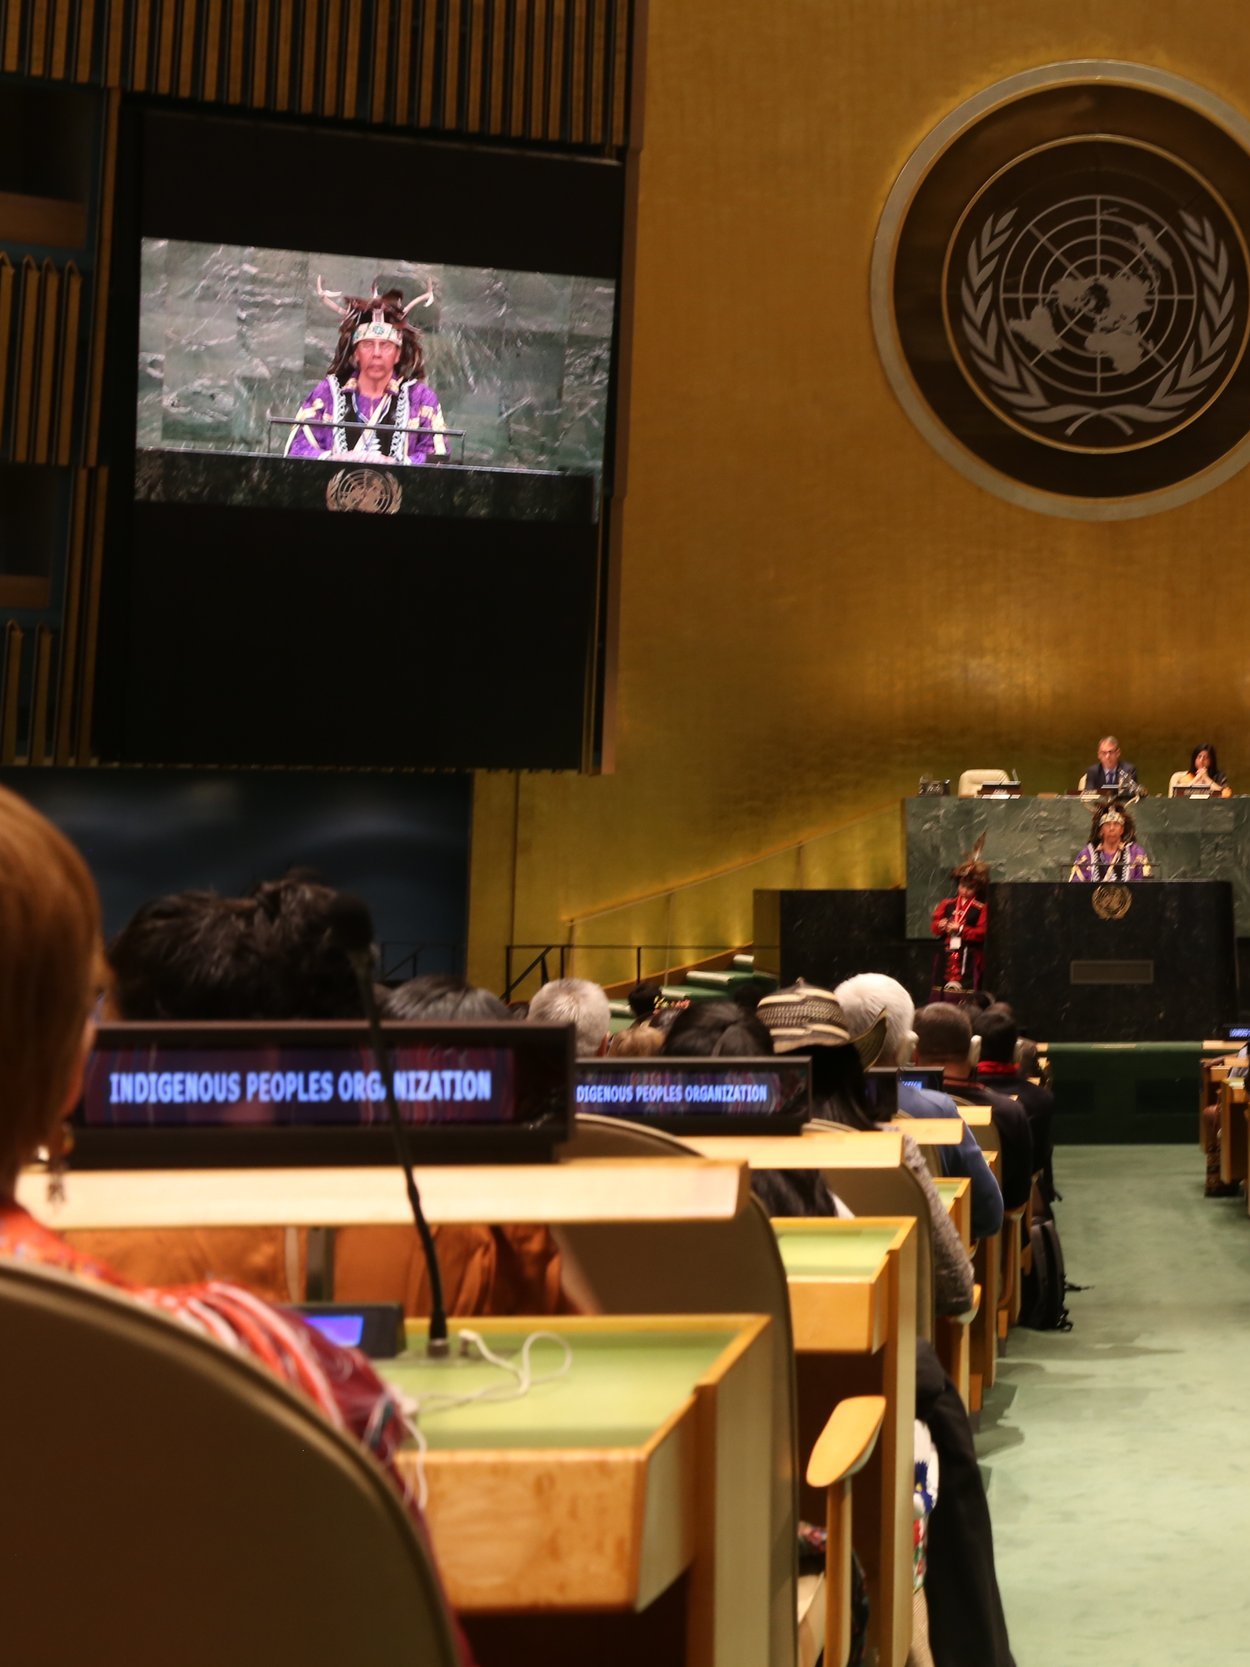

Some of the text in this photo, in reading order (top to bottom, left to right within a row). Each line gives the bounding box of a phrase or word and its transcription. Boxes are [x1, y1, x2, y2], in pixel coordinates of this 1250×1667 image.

[109, 1070, 492, 1104] INDIGENOUS PEOPLES ORGNIZATION
[576, 1084, 768, 1104] DIGENOUS PEOPLES ORGANIZATION
